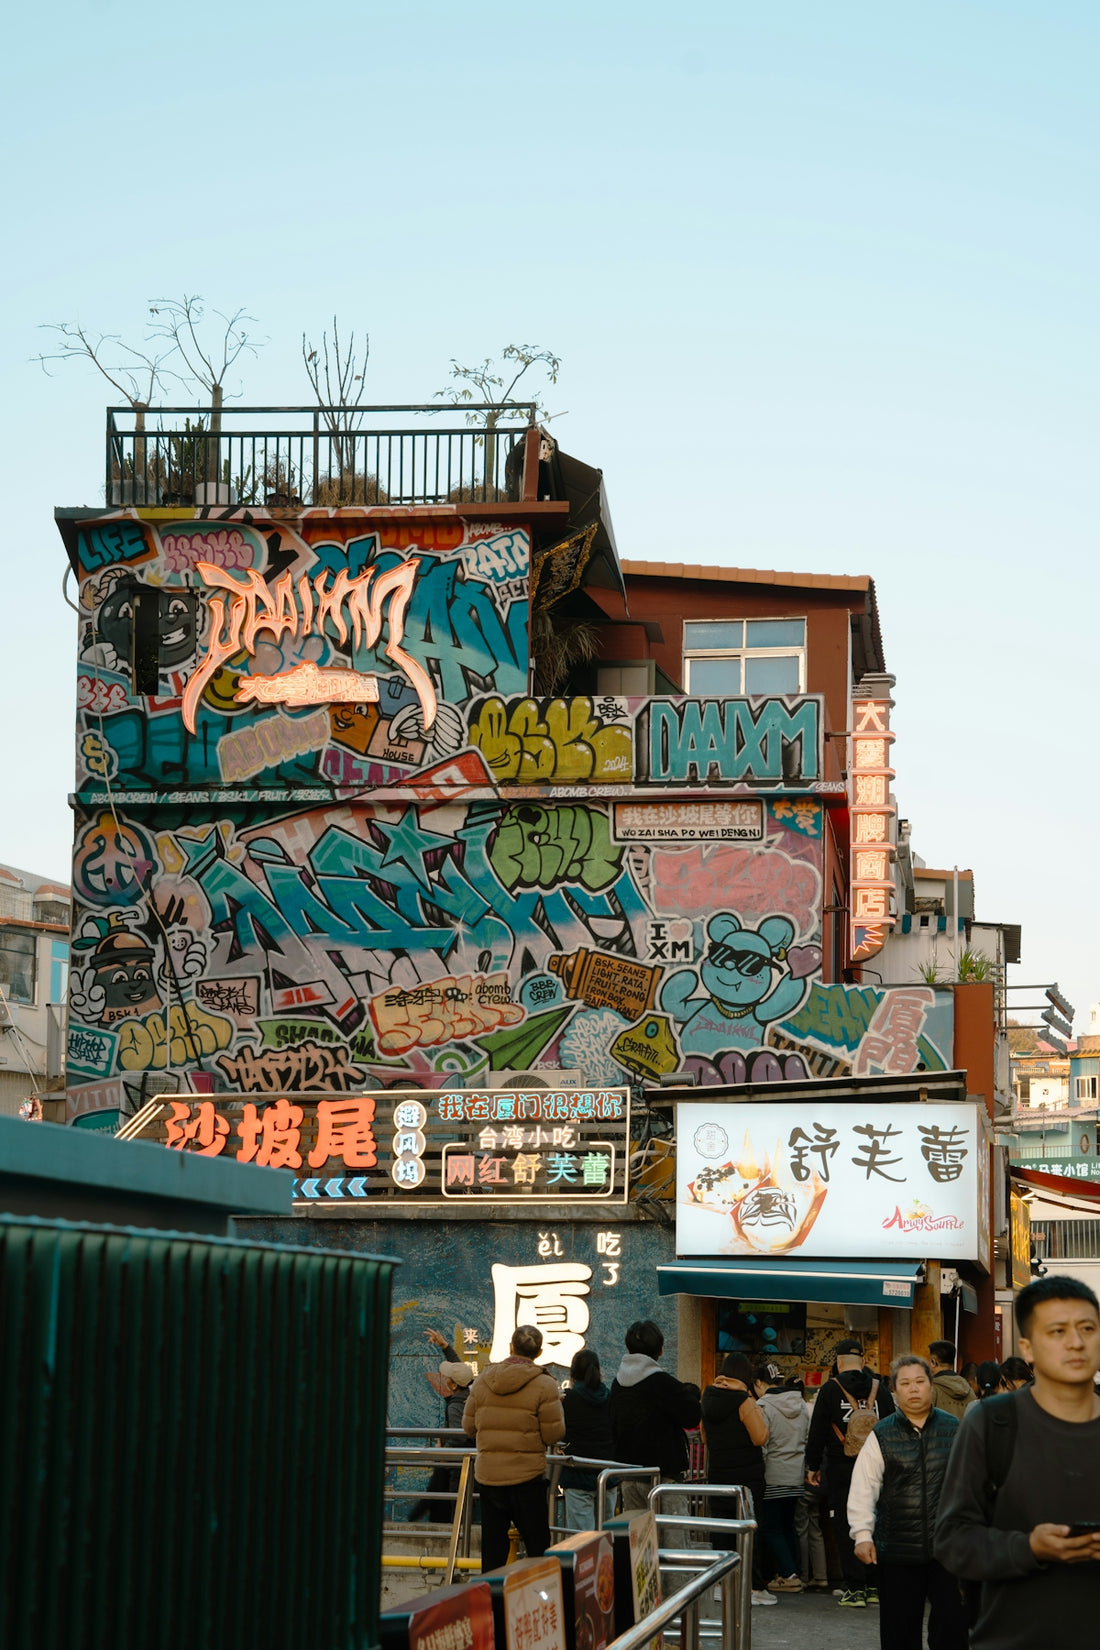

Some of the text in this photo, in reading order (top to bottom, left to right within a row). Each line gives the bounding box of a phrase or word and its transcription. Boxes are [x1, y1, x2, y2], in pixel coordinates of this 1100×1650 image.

[79, 521, 147, 573] LIFE
[382, 748, 415, 762] HOUSE
[621, 803, 759, 826] 我在沙坡尾等你
[622, 829, 761, 839] WO ZAI SHA PO WEI DENG NI
[649, 941, 690, 960] XM
[475, 981, 511, 995] abomb
[438, 1093, 623, 1120] 我在厦门很想你
[165, 1100, 377, 1171] 沙坡尾
[478, 1125, 577, 1149] 台湾小吃
[788, 1122, 970, 1183] 舒芙蕾
[446, 1152, 611, 1186] 网红舒芙蕾
[881, 1205, 924, 1233] Amoy
[597, 1231, 622, 1286] 吃了
